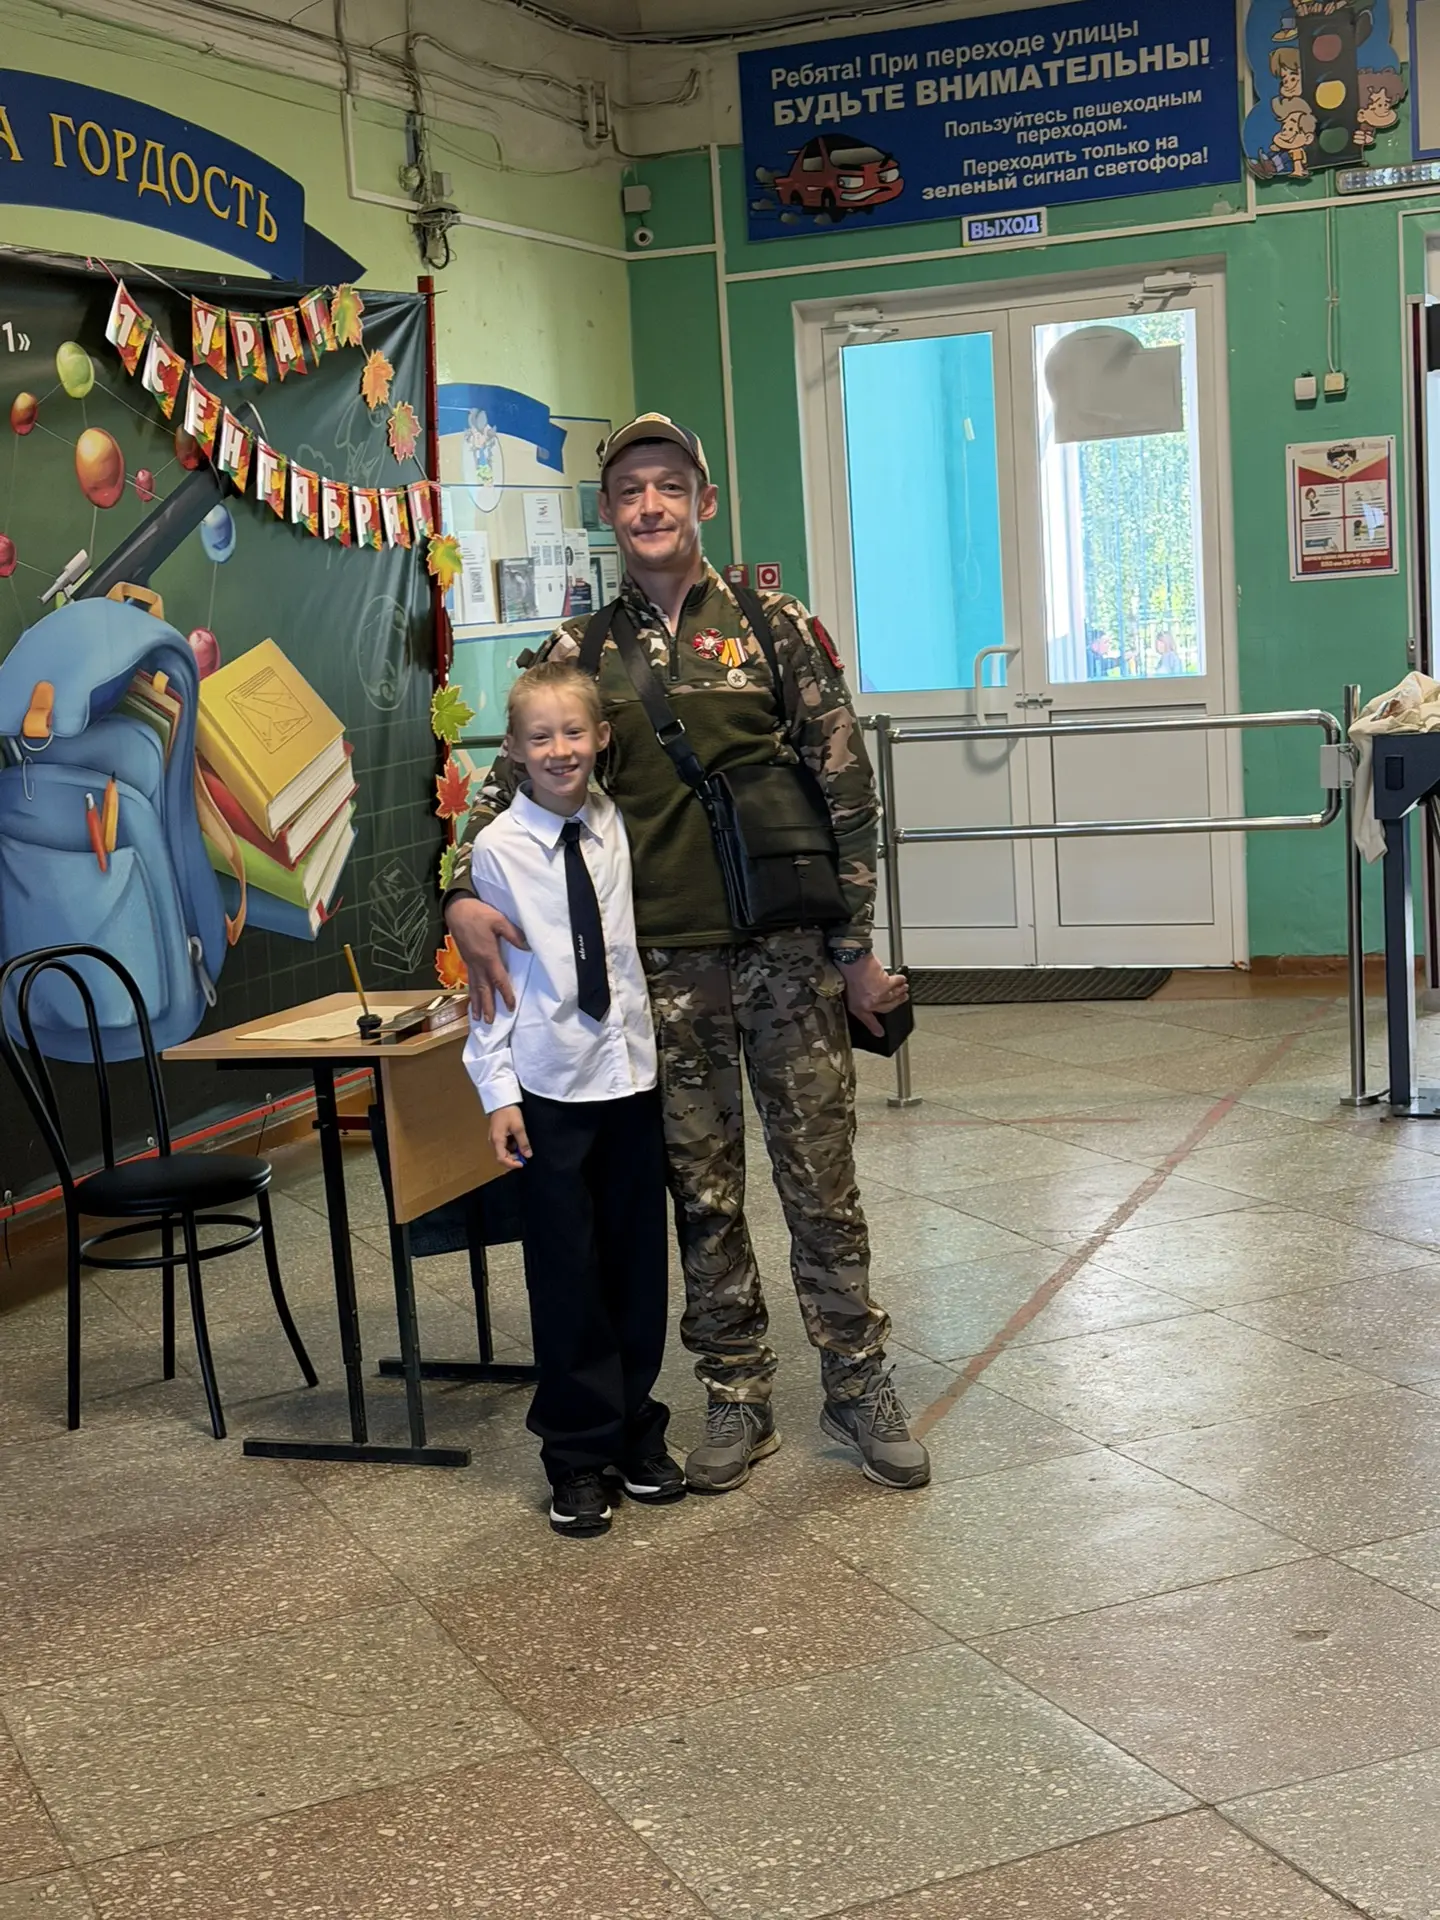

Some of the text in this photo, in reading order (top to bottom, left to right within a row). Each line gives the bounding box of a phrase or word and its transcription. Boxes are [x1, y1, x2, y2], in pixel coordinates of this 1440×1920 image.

[771, 19, 1139, 91] Ребята! При переходе улицы
[773, 37, 1210, 126] БУДЬТЕ ВНИМАТЕЛЬНЫ!
[944, 89, 1202, 139] Пользуйтесь пешеходным
[1016, 117, 1128, 145] переходом.
[49, 112, 278, 243] ГОРДОСТЬ
[921, 146, 1209, 200] зеленый сигнал светофора!
[963, 135, 1179, 177] Переходить только на
[970, 214, 1039, 239] ВЫХОД
[2, 320, 31, 353] 1»
[116, 303, 137, 348] 1
[196, 300, 324, 367] УРА!
